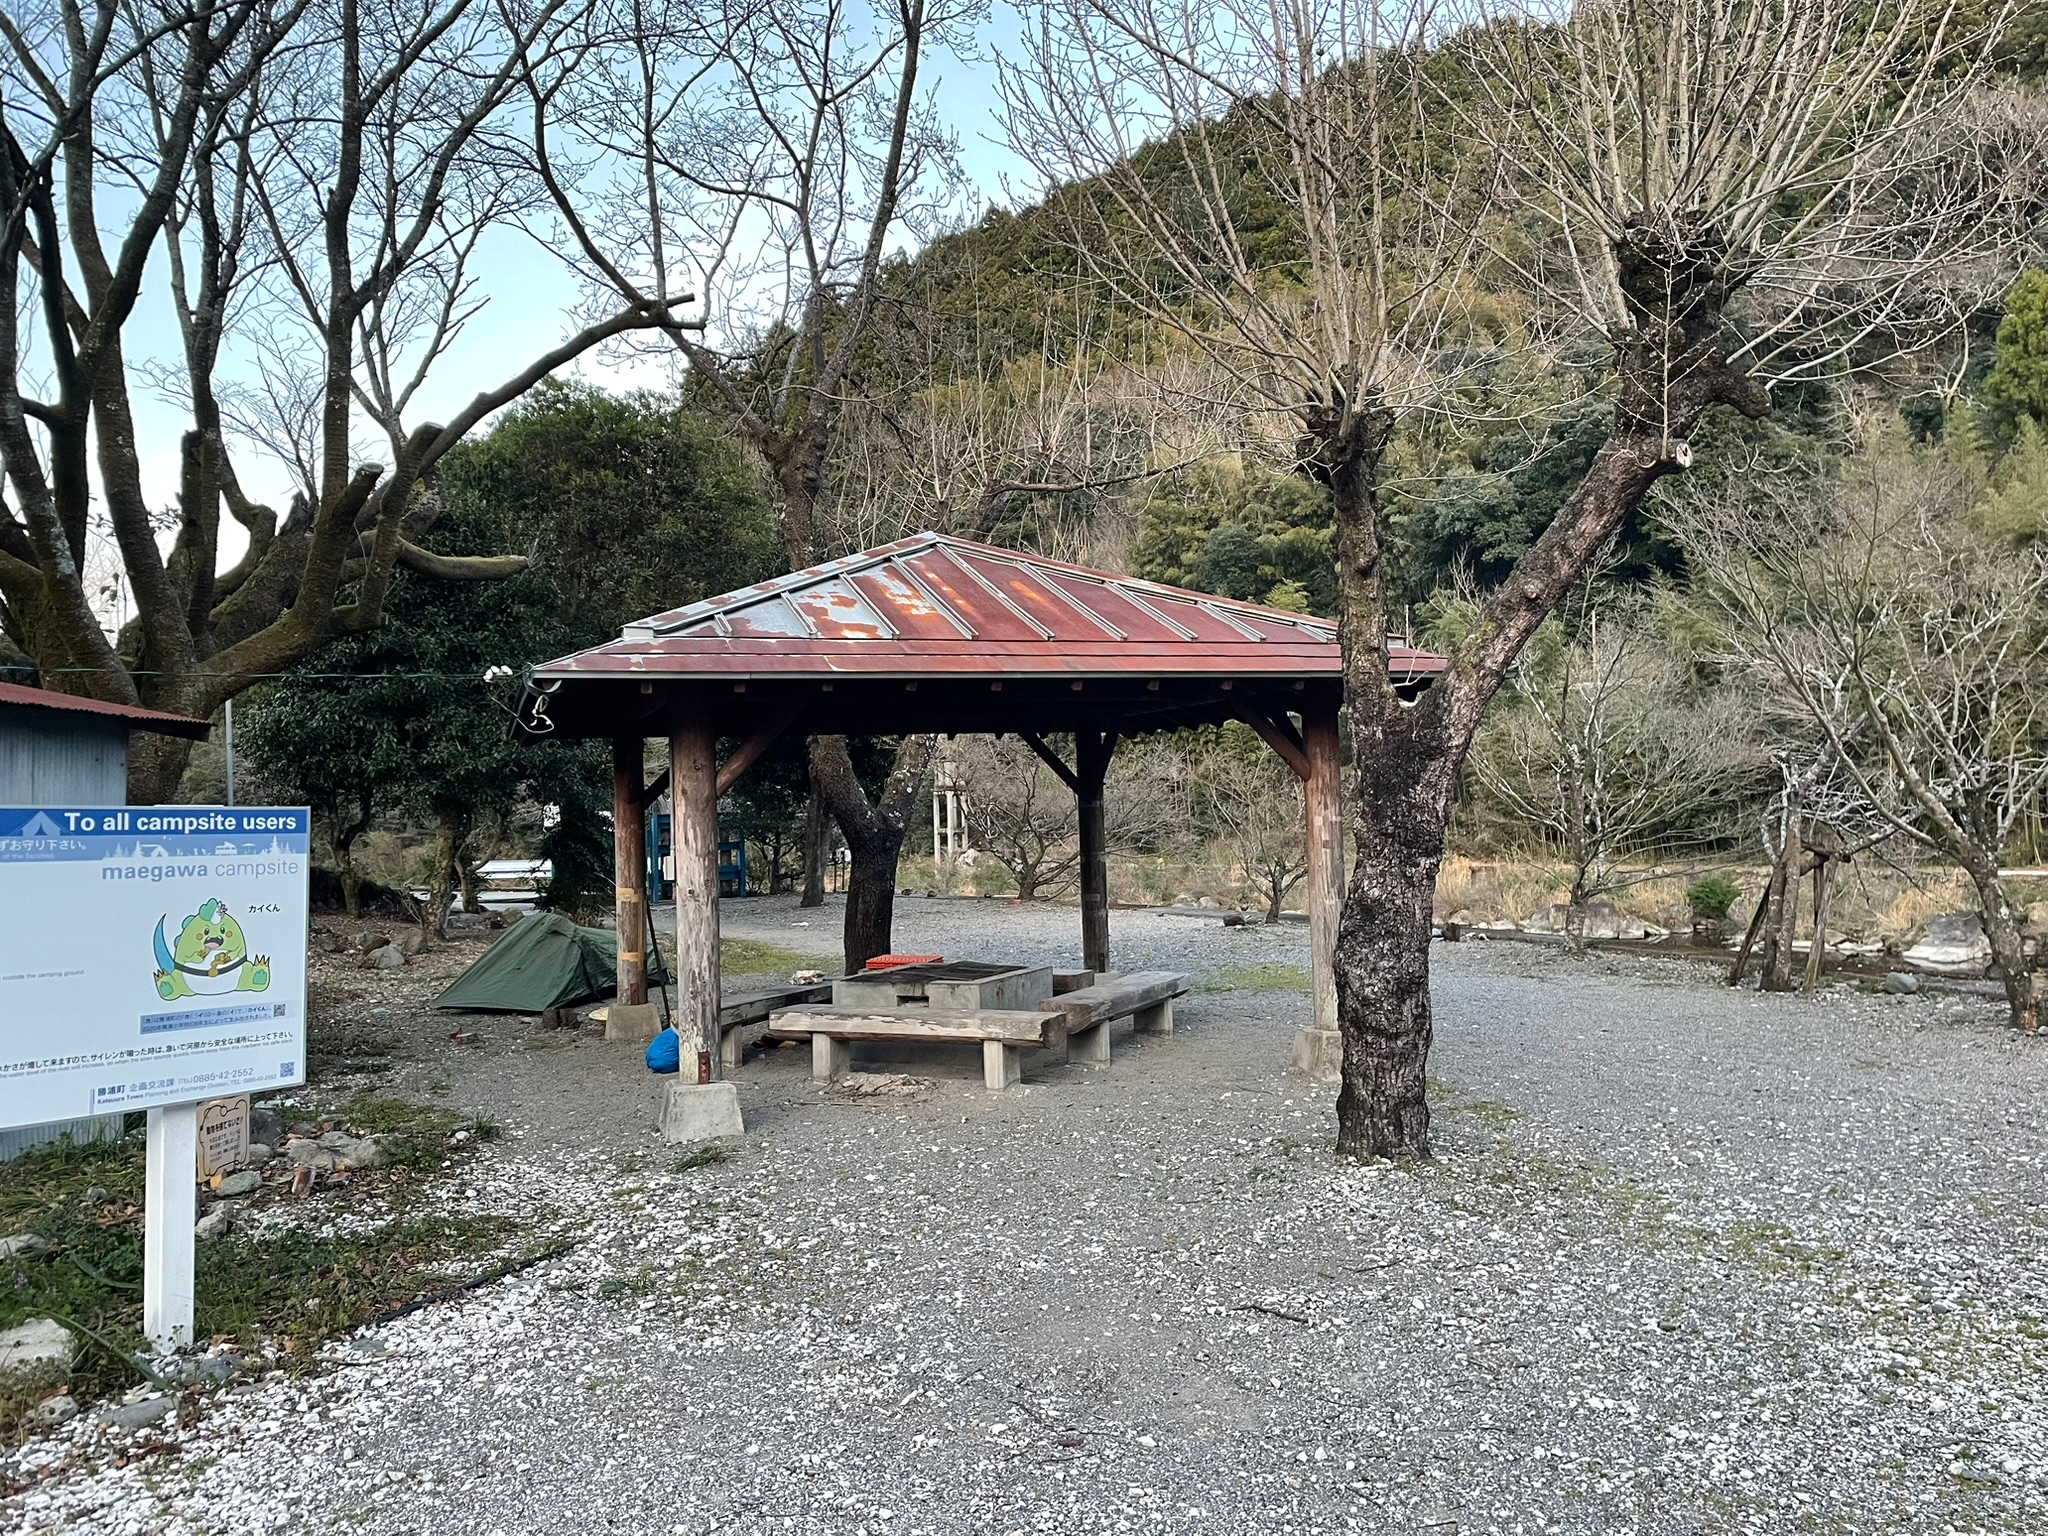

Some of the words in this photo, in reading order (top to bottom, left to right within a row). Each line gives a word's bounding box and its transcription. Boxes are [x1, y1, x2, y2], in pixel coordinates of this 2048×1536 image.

[64, 812, 95, 831] To
[103, 813, 129, 830] all
[137, 813, 236, 834] campsite
[243, 815, 297, 830] users
[102, 864, 208, 882] maegawa
[215, 859, 298, 879] campsite
[248, 903, 281, 914] カイくん
[97, 1084, 126, 1096] 勝浦町
